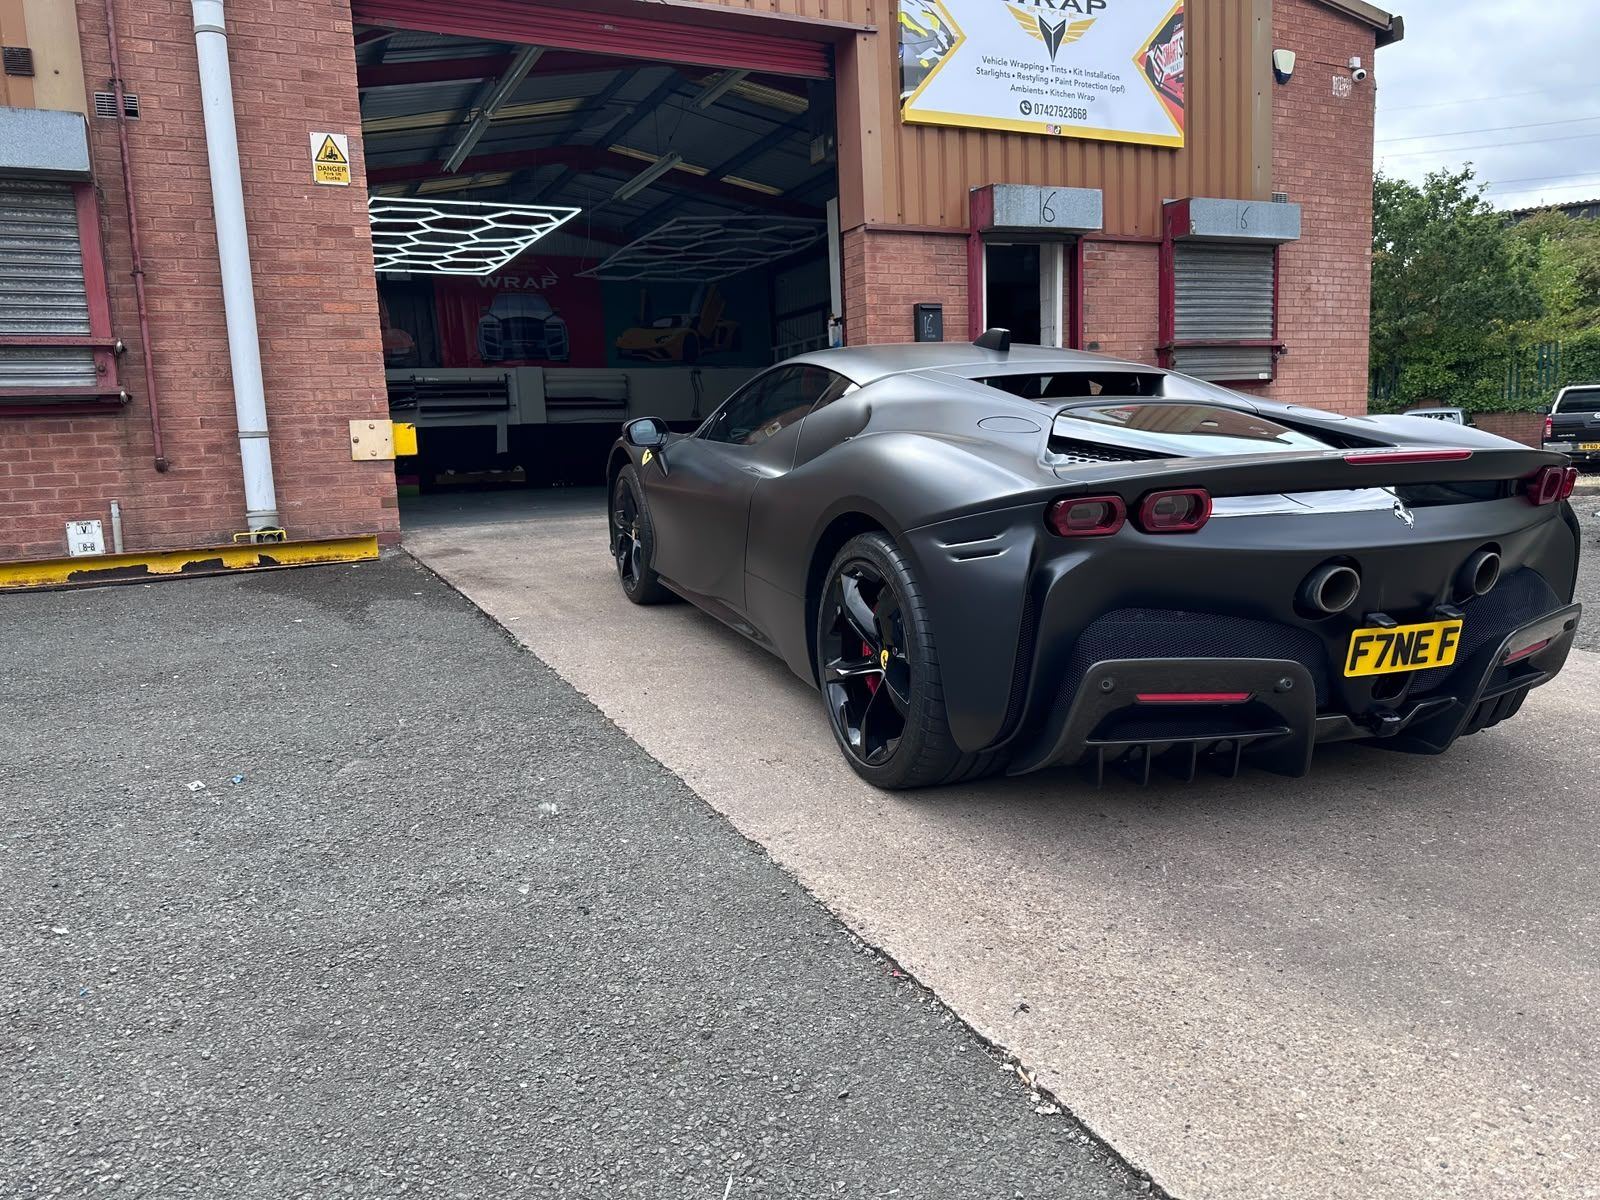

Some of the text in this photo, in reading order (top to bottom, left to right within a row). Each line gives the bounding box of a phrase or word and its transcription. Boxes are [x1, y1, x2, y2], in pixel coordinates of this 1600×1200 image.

[982, 55, 1008, 66] Vehicle
[1050, 64, 1067, 74] Tints
[1073, 67, 1083, 76] Kit
[1084, 69, 1120, 81] Installation
[976, 66, 1126, 94] Starlights Restyling Paint Protection (ppf)
[1010, 84, 1096, 102] Ambients Kitchen Wrap
[1034, 103, 1088, 120] 07427523668
[317, 165, 347, 173] DANGER
[1039, 190, 1057, 224] 16
[1236, 204, 1250, 230] 16
[476, 276, 557, 288] WRAP
[924, 314, 933, 337] 16
[81, 526, 87, 534] V
[1349, 626, 1460, 671] F7NE F
